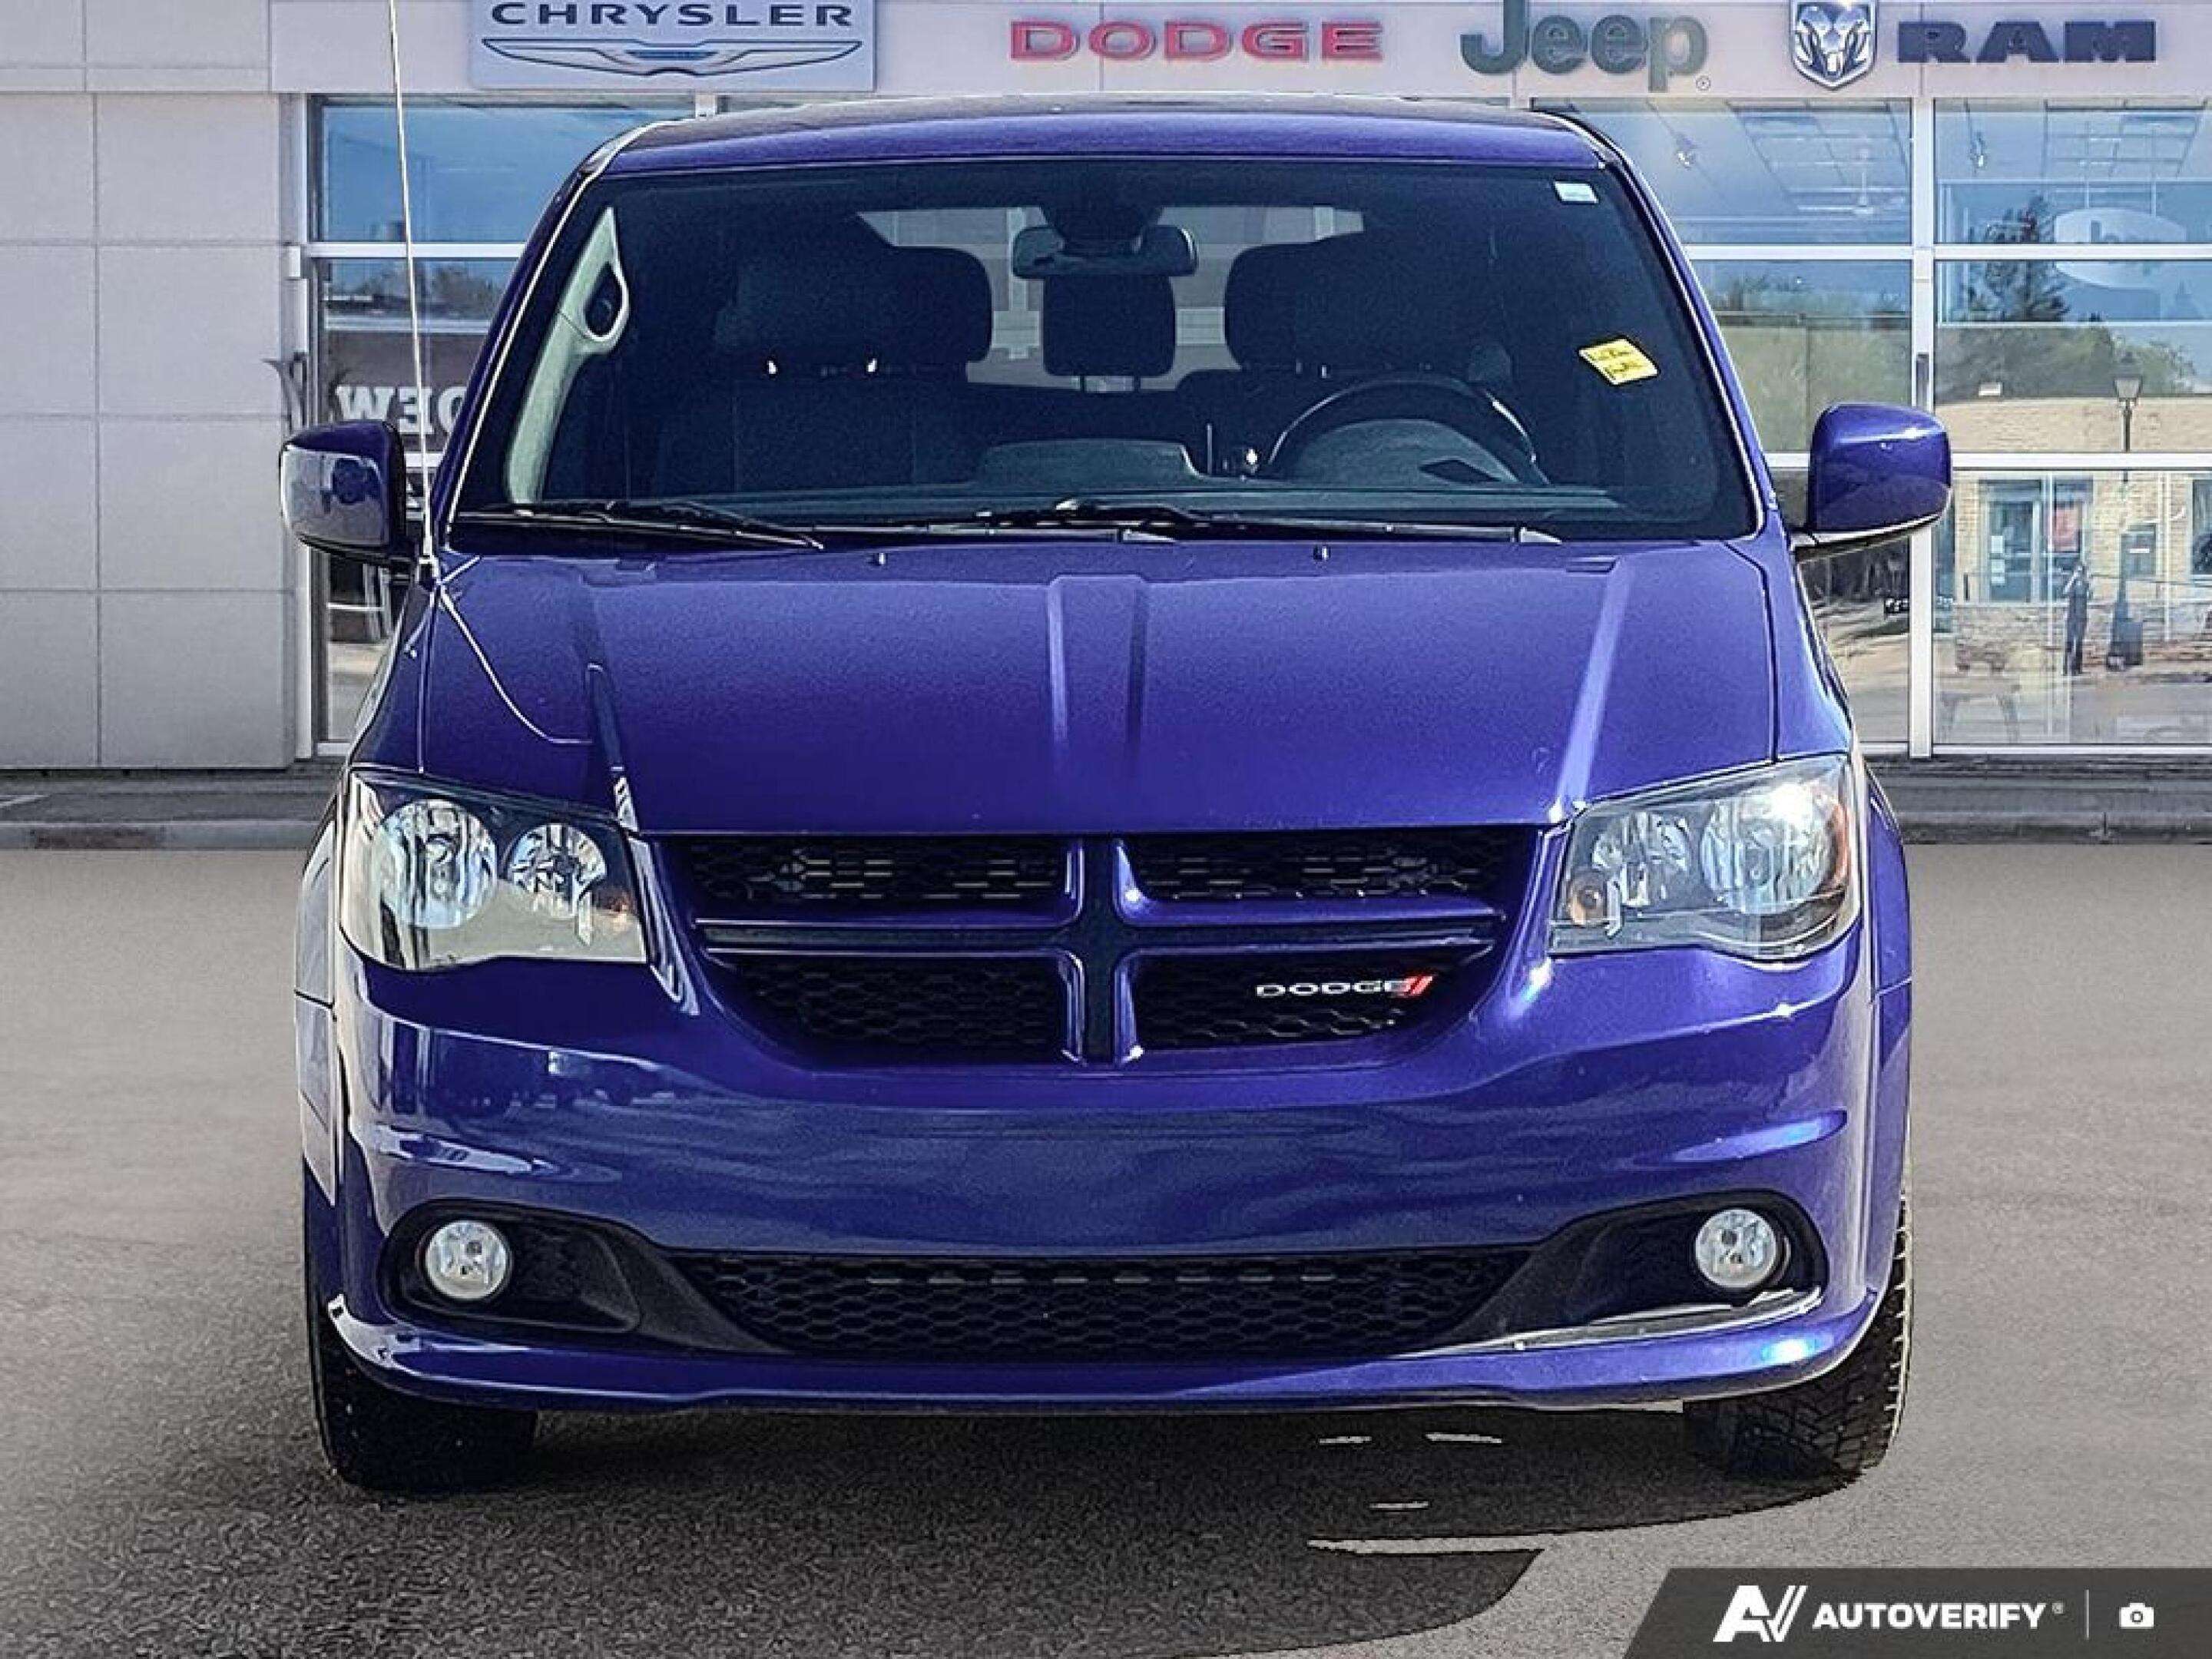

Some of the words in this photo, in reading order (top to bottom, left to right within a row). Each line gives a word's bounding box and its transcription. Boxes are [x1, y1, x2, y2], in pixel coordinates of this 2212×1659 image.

[491, 2, 853, 27] CHRYSLER
[1009, 20, 1382, 61] DODGE
[1460, 0, 1708, 93] Jeep
[1898, 21, 2156, 64] RAM
[1256, 980, 1410, 997] DODGE
